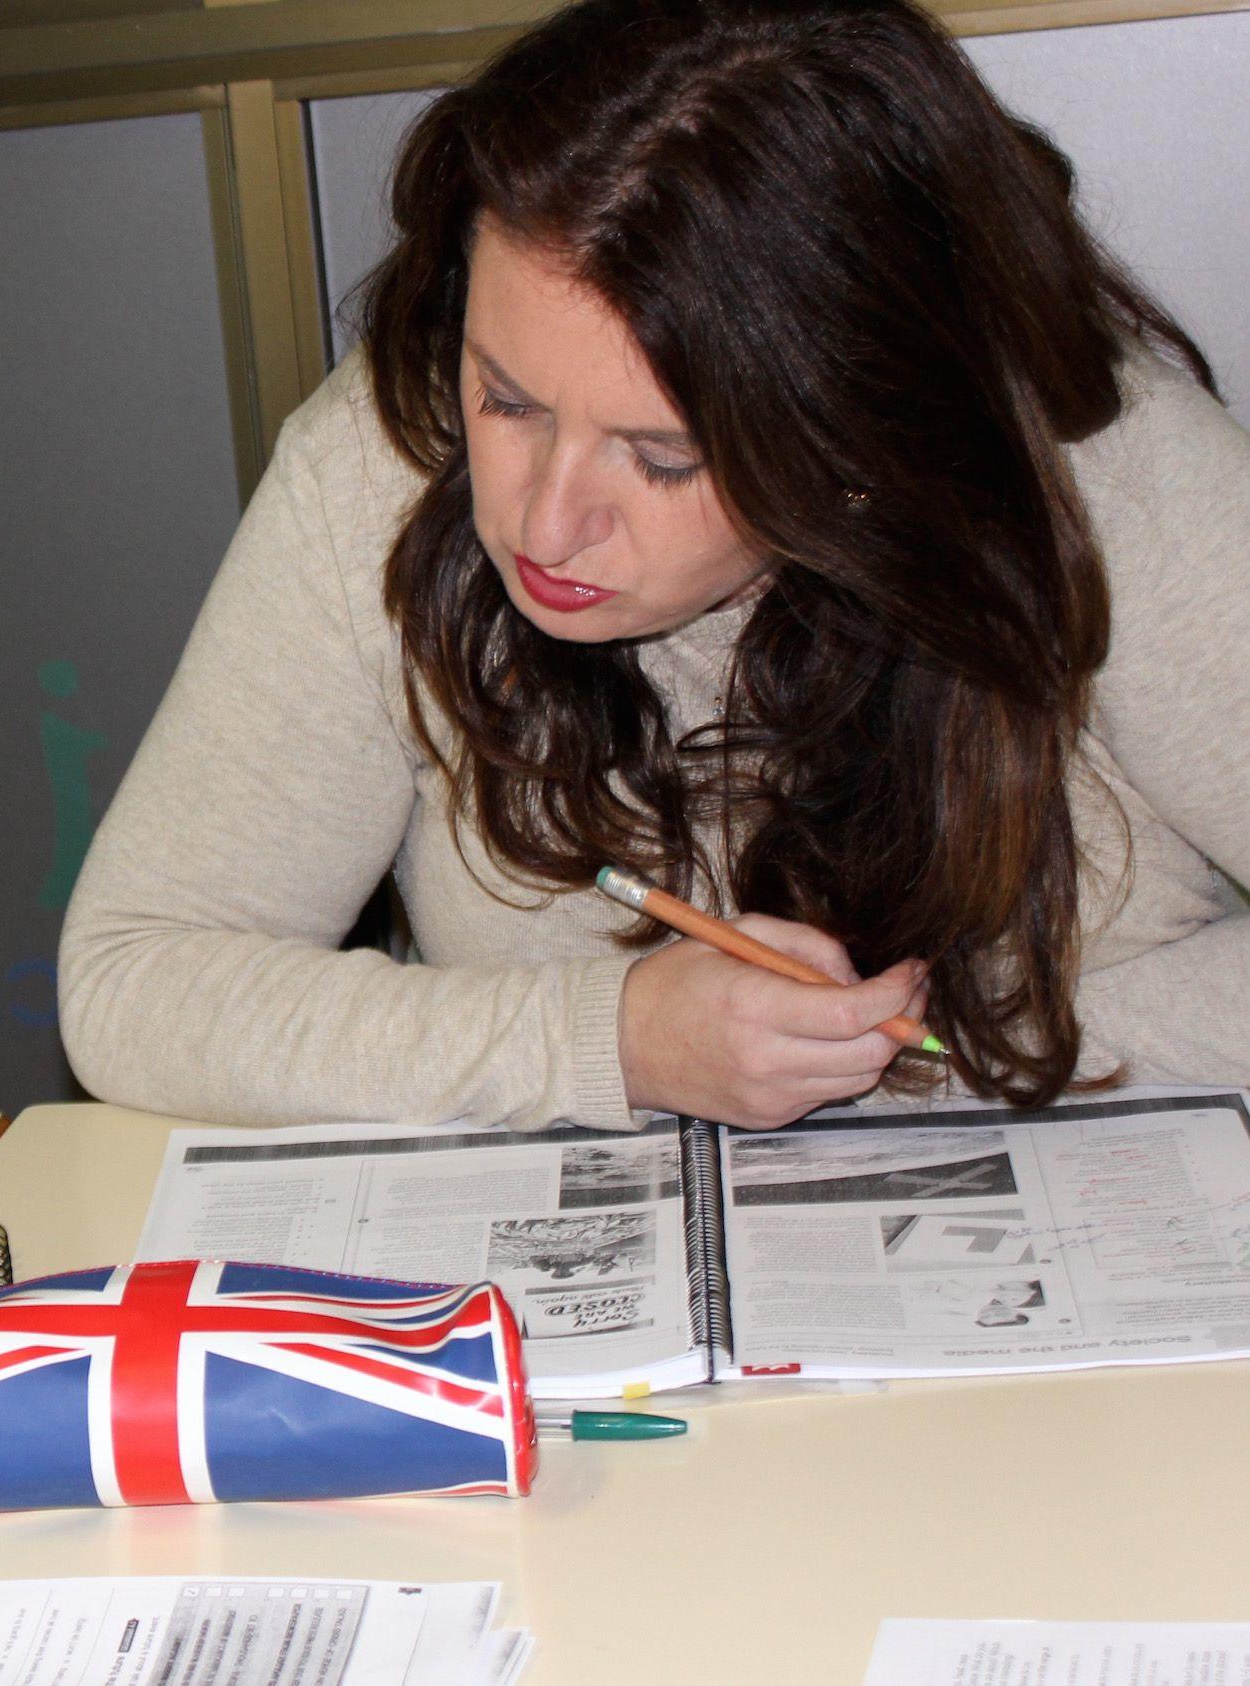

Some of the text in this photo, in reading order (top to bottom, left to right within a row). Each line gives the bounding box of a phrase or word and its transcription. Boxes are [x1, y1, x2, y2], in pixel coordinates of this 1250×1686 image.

[544, 1293, 646, 1316] CLOSED
[573, 1309, 640, 1328] Sorry
[942, 1335, 1191, 1357] Society and the media
